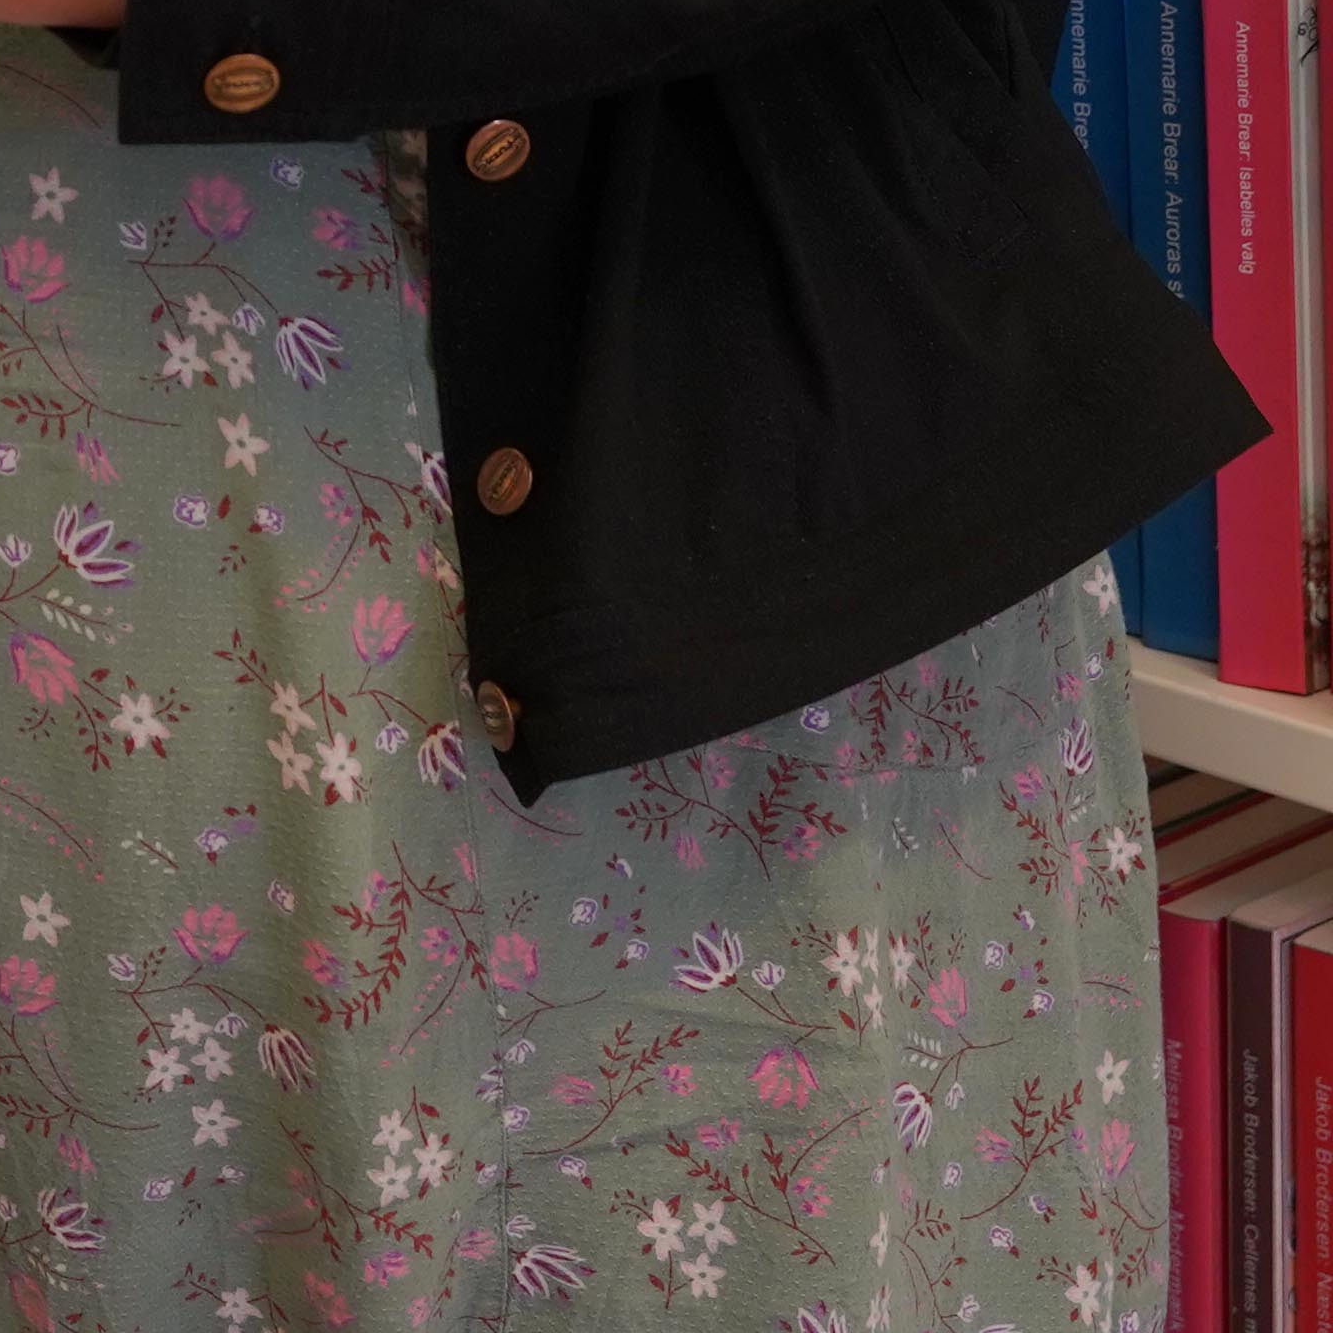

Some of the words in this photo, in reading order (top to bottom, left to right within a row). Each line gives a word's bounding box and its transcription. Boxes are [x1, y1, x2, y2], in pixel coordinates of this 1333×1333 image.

[1160, 1, 1181, 116] Annemarie
[1236, 21, 1252, 108] Annemarie
[1163, 122, 1182, 183] Brear:
[1237, 113, 1253, 161] Brear:
[1165, 190, 1184, 274] Auroras
[1239, 166, 1256, 237] Isabelles
[1237, 241, 1256, 275] valg
[1166, 1038, 1183, 1119] Melissa
[1243, 1048, 1260, 1108] Jakob
[1315, 1077, 1333, 1141] Jakob
[1243, 1223, 1260, 1313] Cellernes
